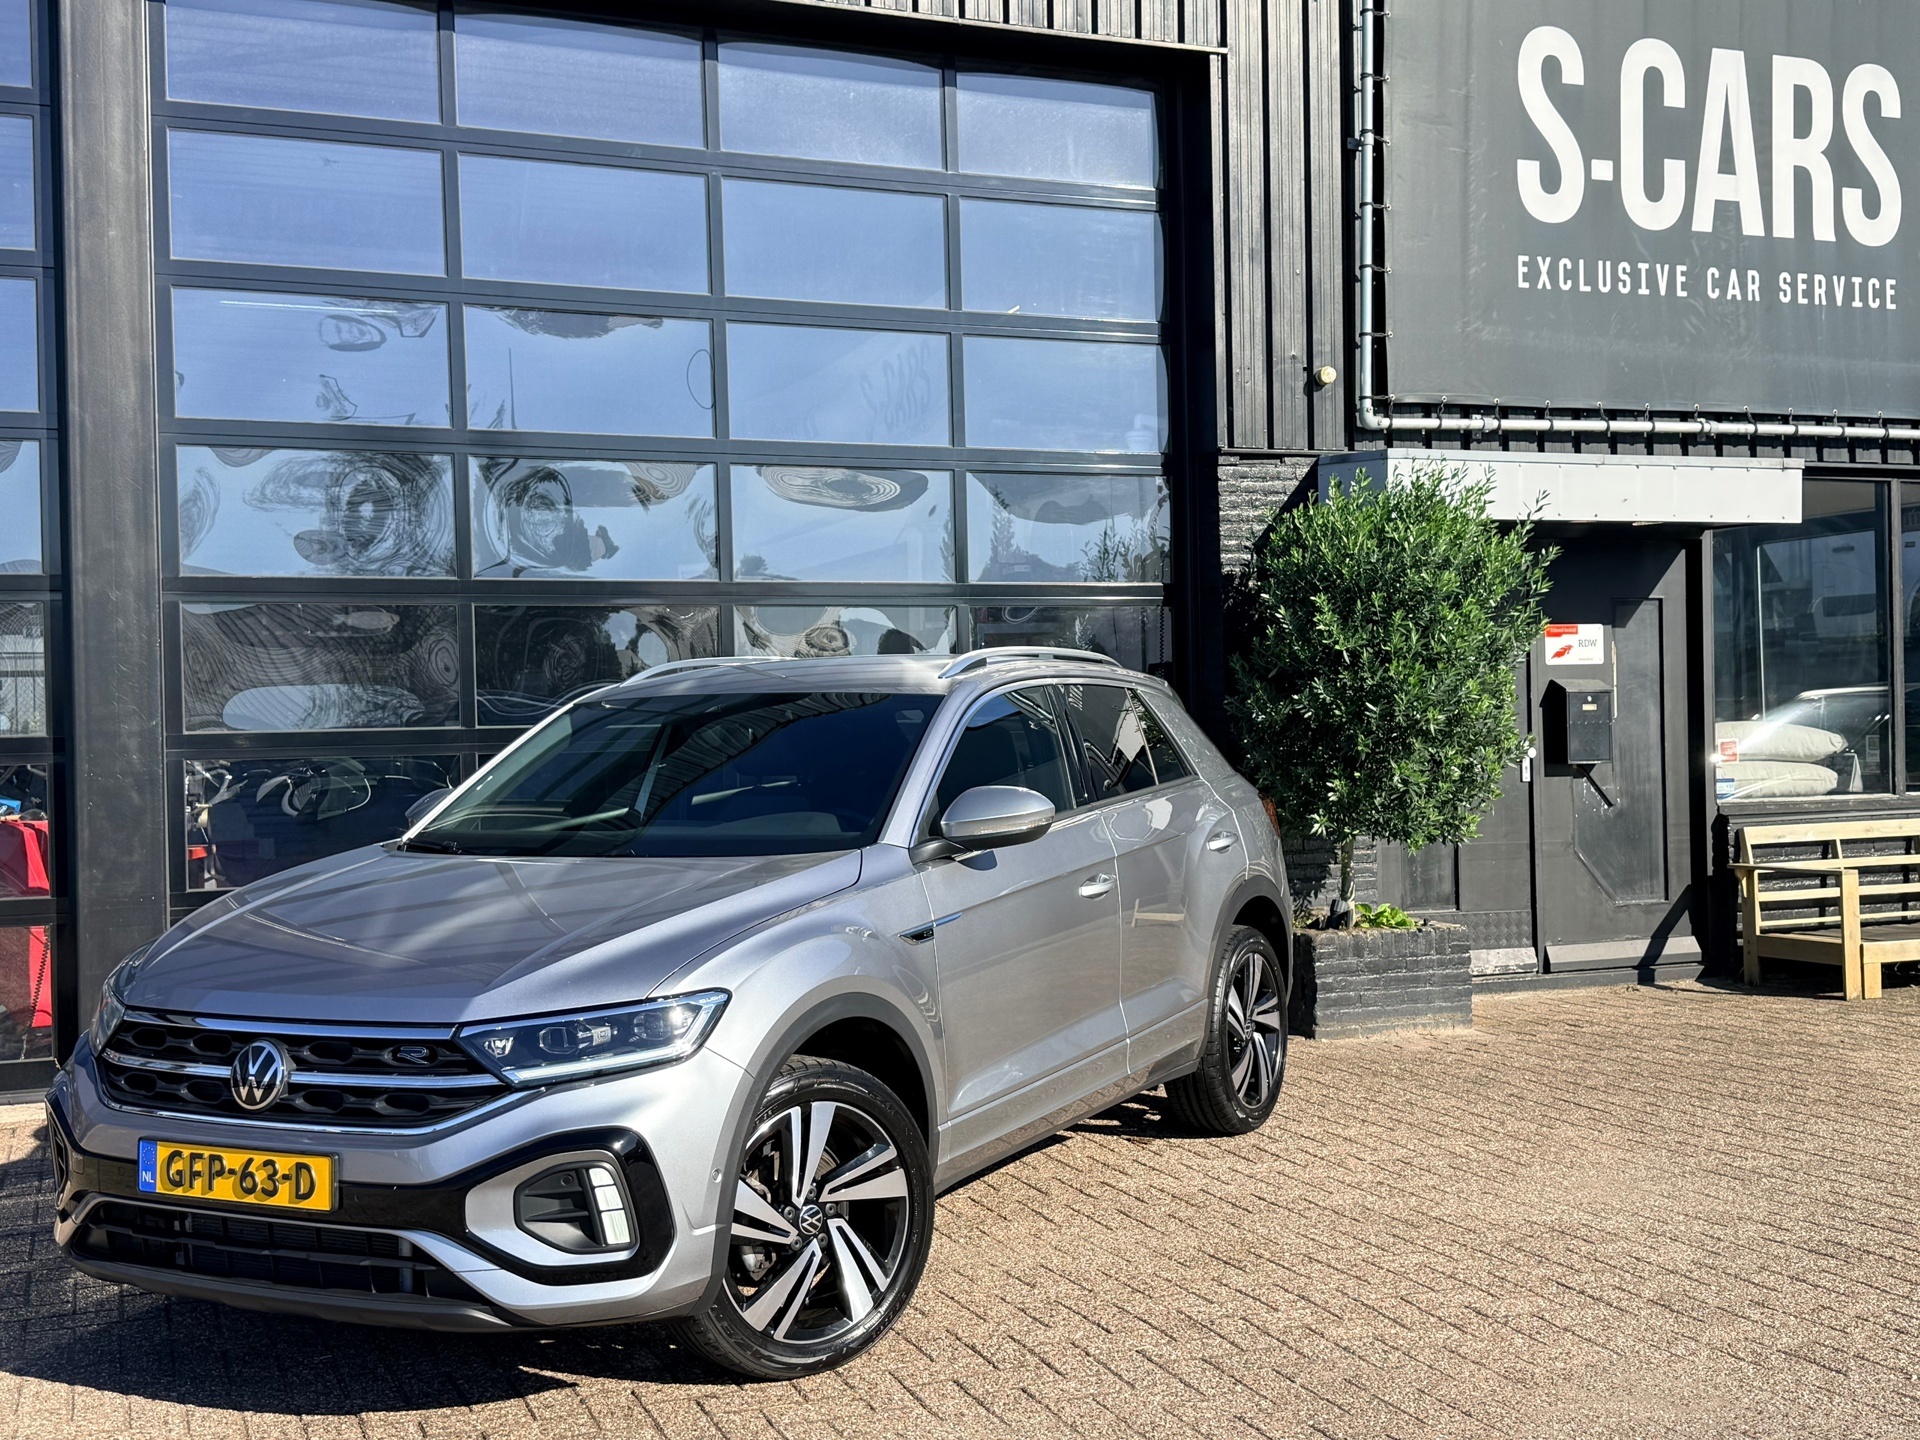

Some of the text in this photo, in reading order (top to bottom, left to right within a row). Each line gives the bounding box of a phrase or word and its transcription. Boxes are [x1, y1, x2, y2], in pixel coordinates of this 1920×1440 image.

[1517, 25, 1902, 247] S-CARS
[1517, 254, 1897, 310] EXCLUSIVE CAR SERVICE
[1578, 639, 1598, 648] RDW
[142, 1171, 155, 1183] NL
[166, 1150, 316, 1200] GFP-63-D
